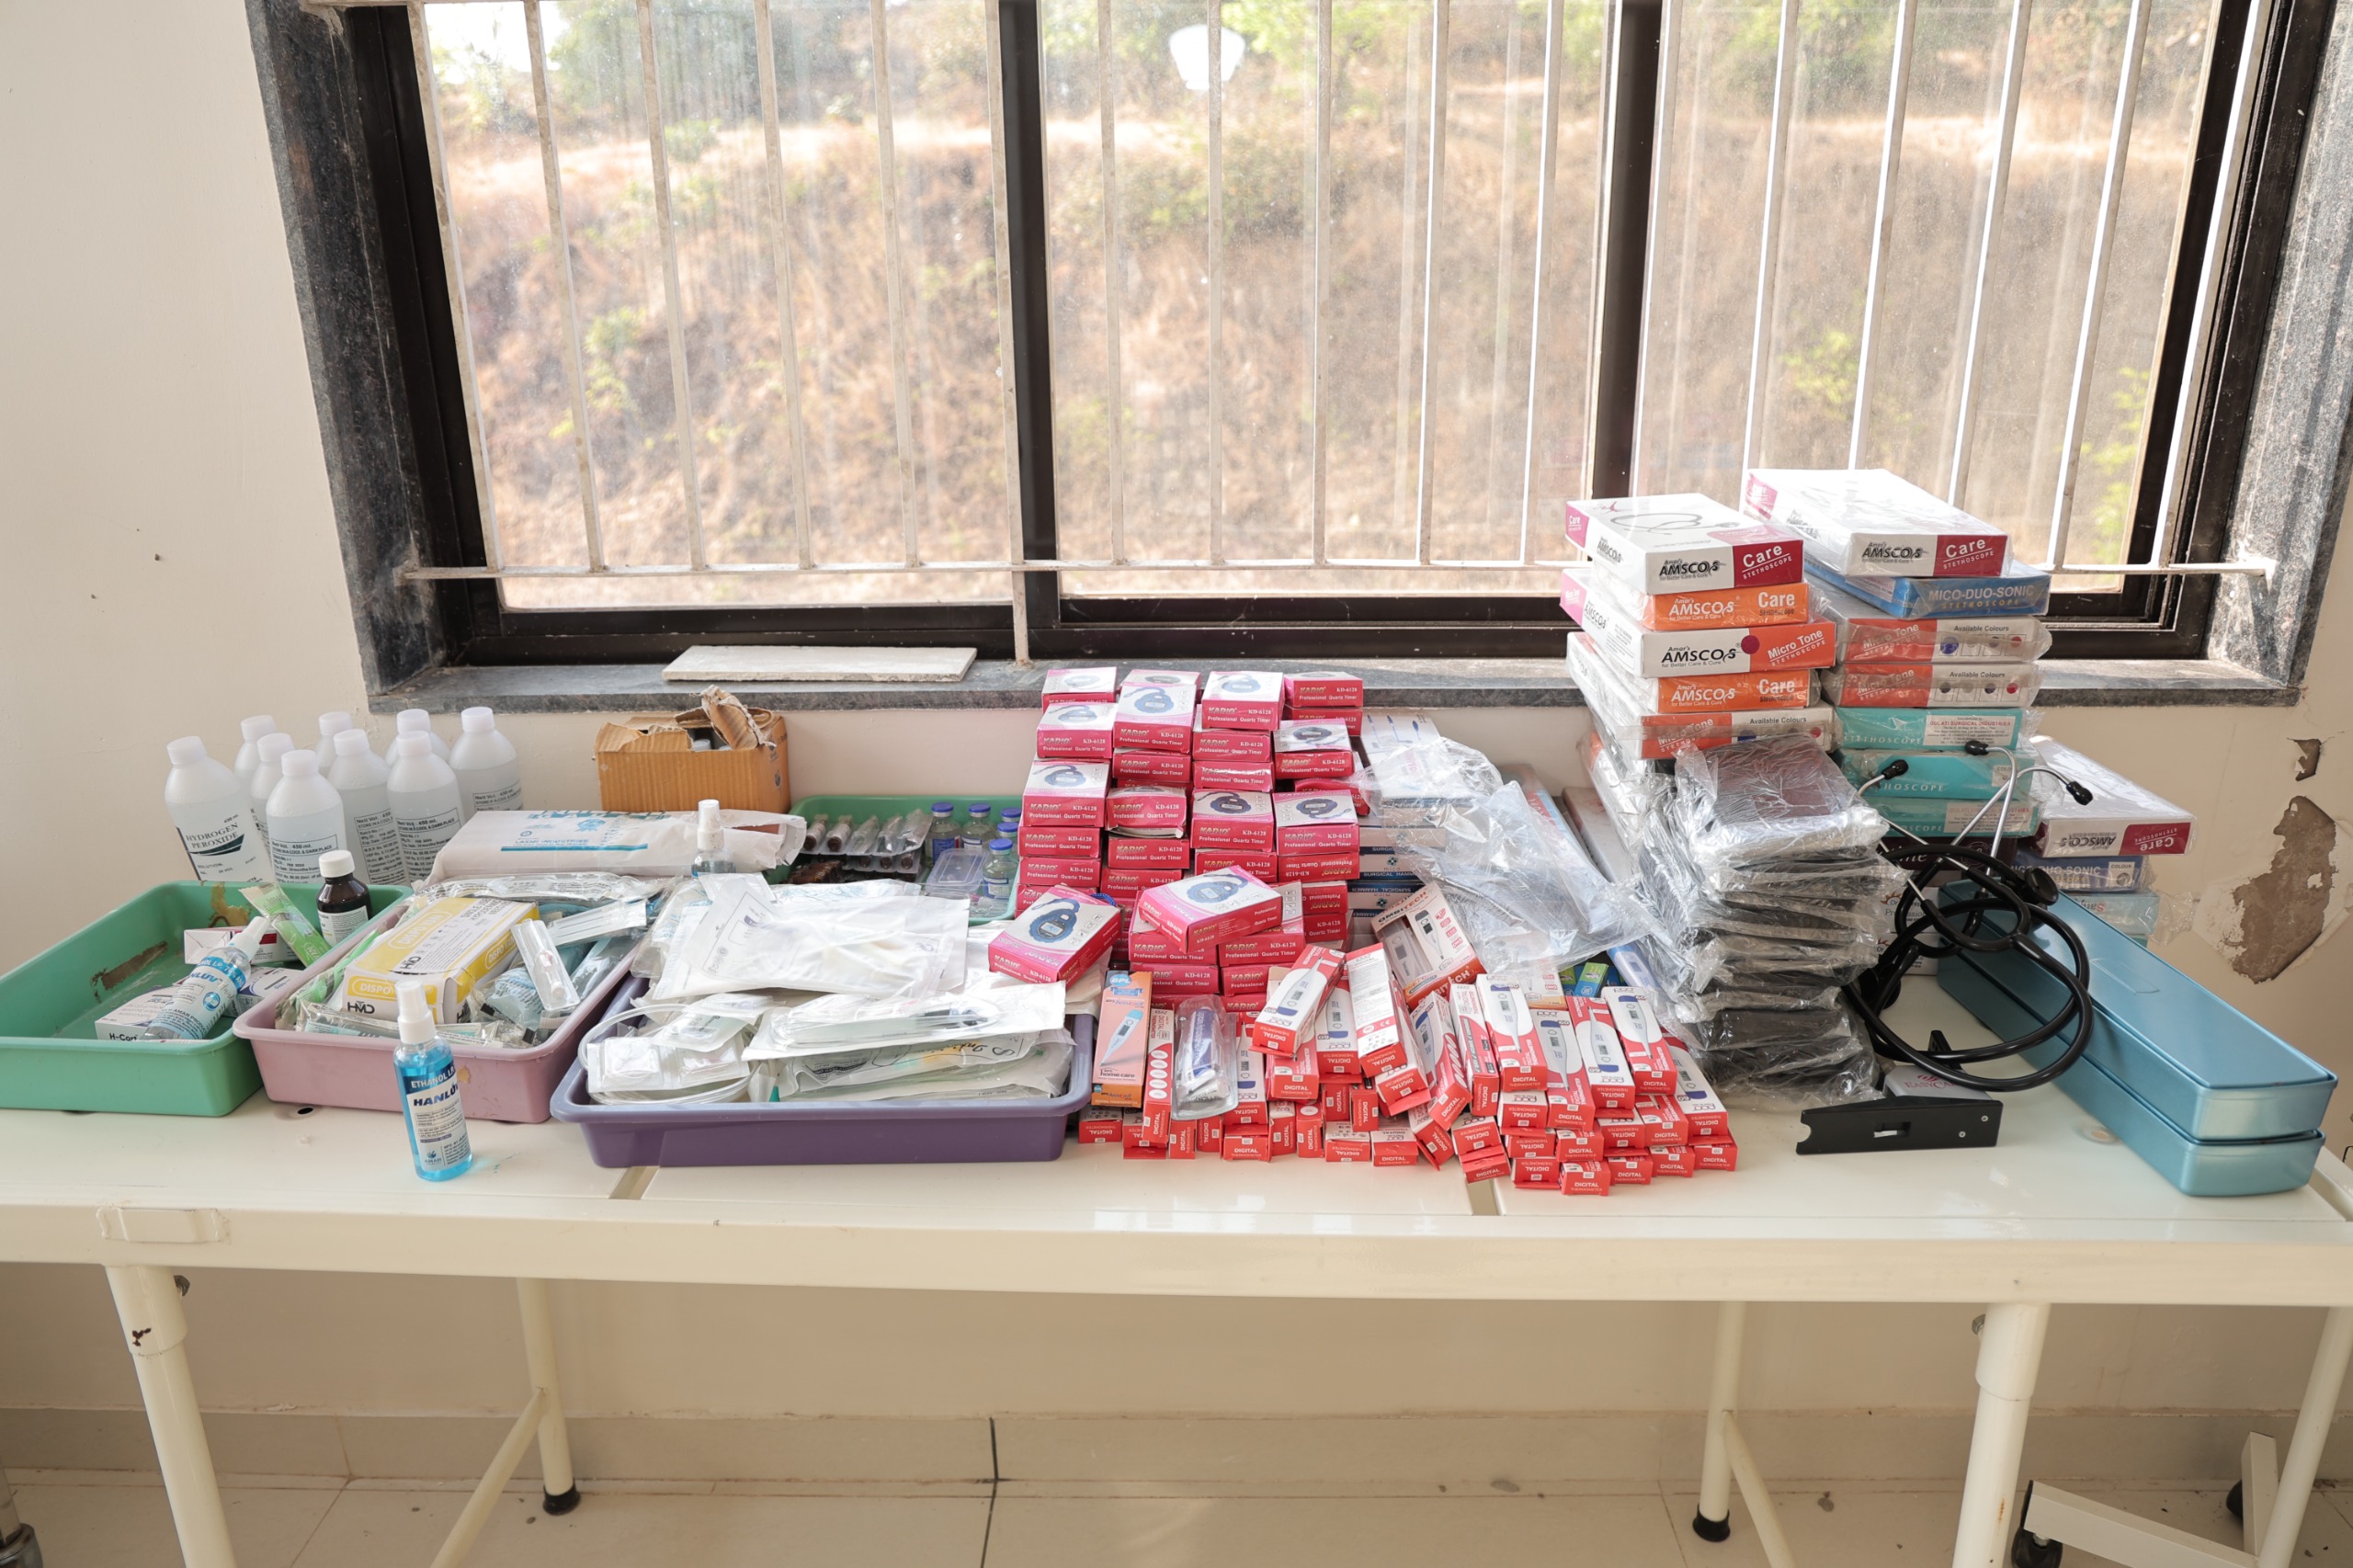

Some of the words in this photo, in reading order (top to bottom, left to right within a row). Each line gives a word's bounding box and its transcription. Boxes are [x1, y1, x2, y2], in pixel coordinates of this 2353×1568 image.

[1569, 516, 1580, 525] Care
[1946, 537, 1986, 558] Care
[1743, 544, 1783, 568] Care
[1943, 551, 1995, 570] STETHOSCOPE
[1743, 555, 1792, 580] STETHOSCOPE
[1757, 592, 1795, 608] Care
[1928, 585, 2036, 601] MICO-DUO-SONIC
[1941, 599, 2019, 608] STETHOSCOPE
[1895, 623, 1919, 637] Tone
[1768, 641, 1796, 660] Micro
[1797, 629, 1824, 646] Tone
[1770, 639, 1825, 667] STETHOSCOPE
[1890, 669, 1915, 683] Tone
[1759, 678, 1795, 695] Care
[1781, 716, 1807, 724] Colours
[186, 823, 238, 842] HYDROGEN
[191, 831, 238, 848] PEROXIDE
[2139, 835, 2174, 852] Care
[489, 946, 505, 962] DISPO
[360, 983, 392, 994] DISPO
[1263, 1031, 1286, 1041] DIGITAL
[411, 1074, 448, 1088] ETHANOL
[1441, 1097, 1460, 1117] DIGITAL
